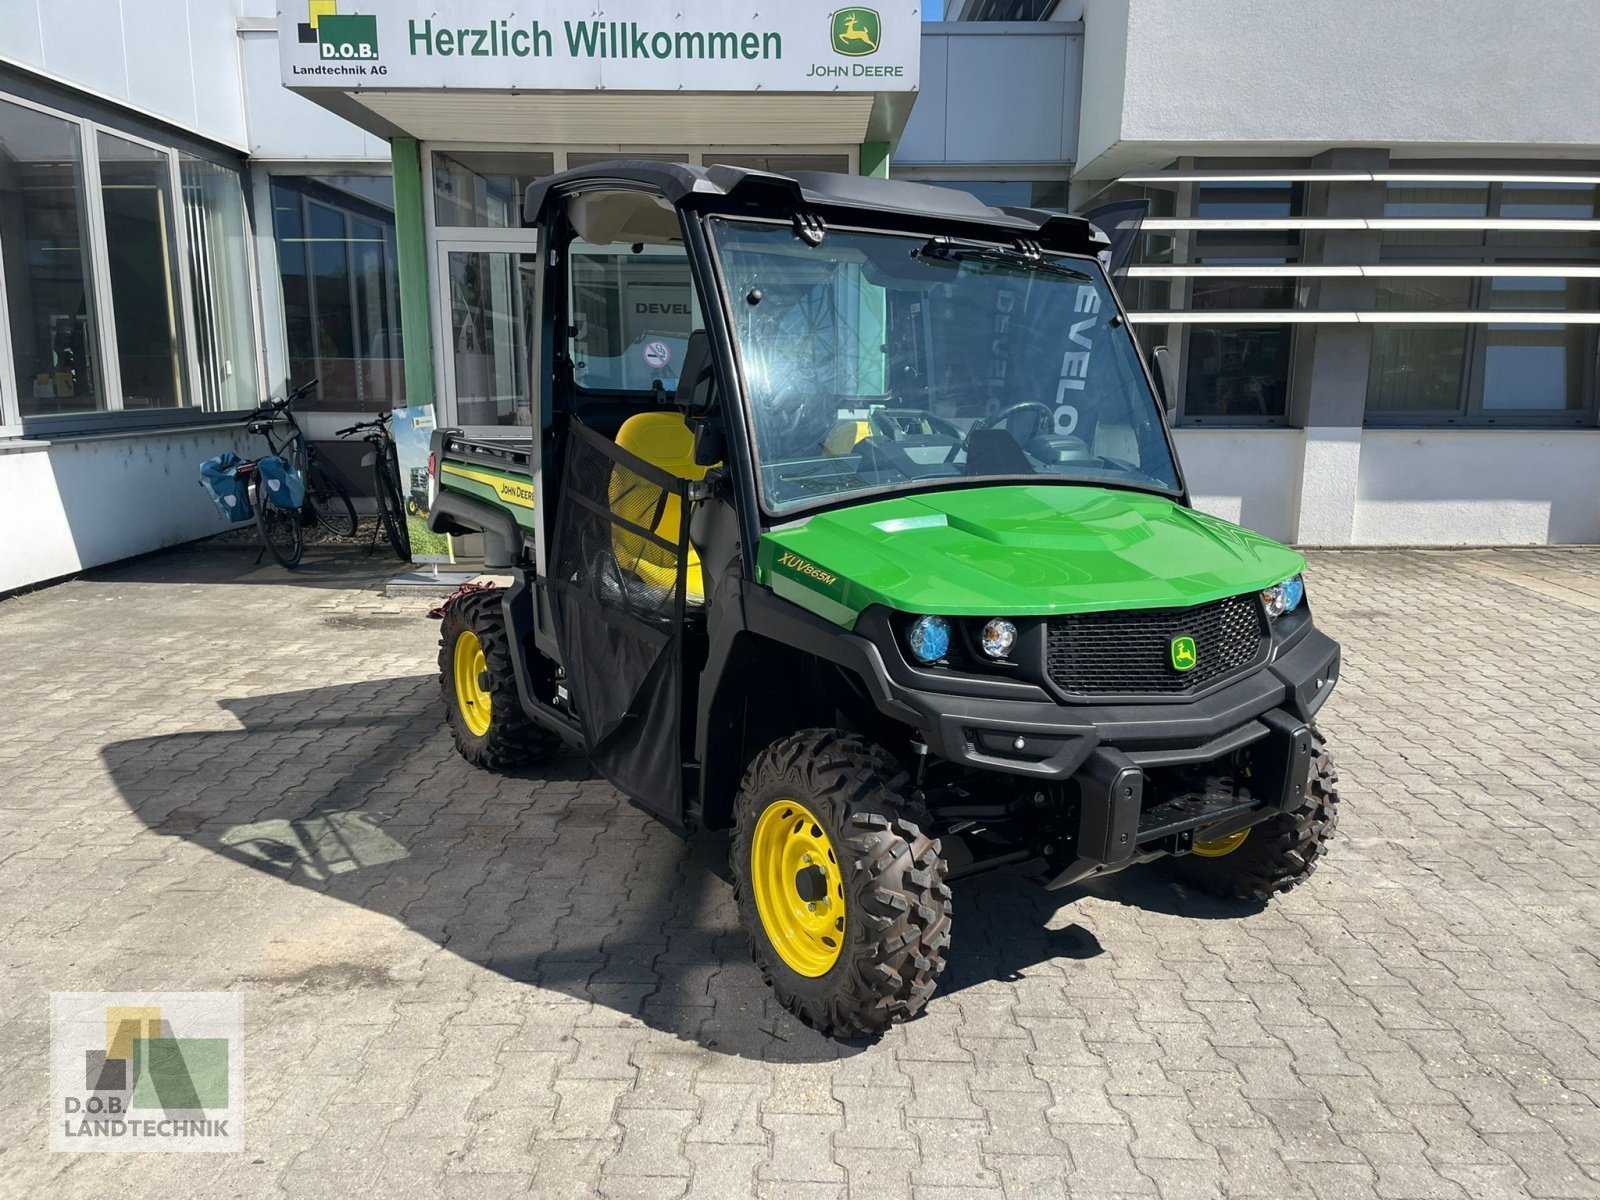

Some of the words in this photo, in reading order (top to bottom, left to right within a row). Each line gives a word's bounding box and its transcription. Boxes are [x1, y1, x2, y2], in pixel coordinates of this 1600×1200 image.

[408, 19, 553, 57] Herzlich
[563, 20, 783, 60] Willkommen
[321, 43, 378, 58] D.O.B.
[292, 65, 367, 75] Landtechnik
[370, 66, 388, 75] AG
[806, 63, 849, 77] JOHN
[852, 64, 904, 77] DEERE
[501, 483, 516, 496] JOHN
[777, 551, 837, 585] XUV865M
